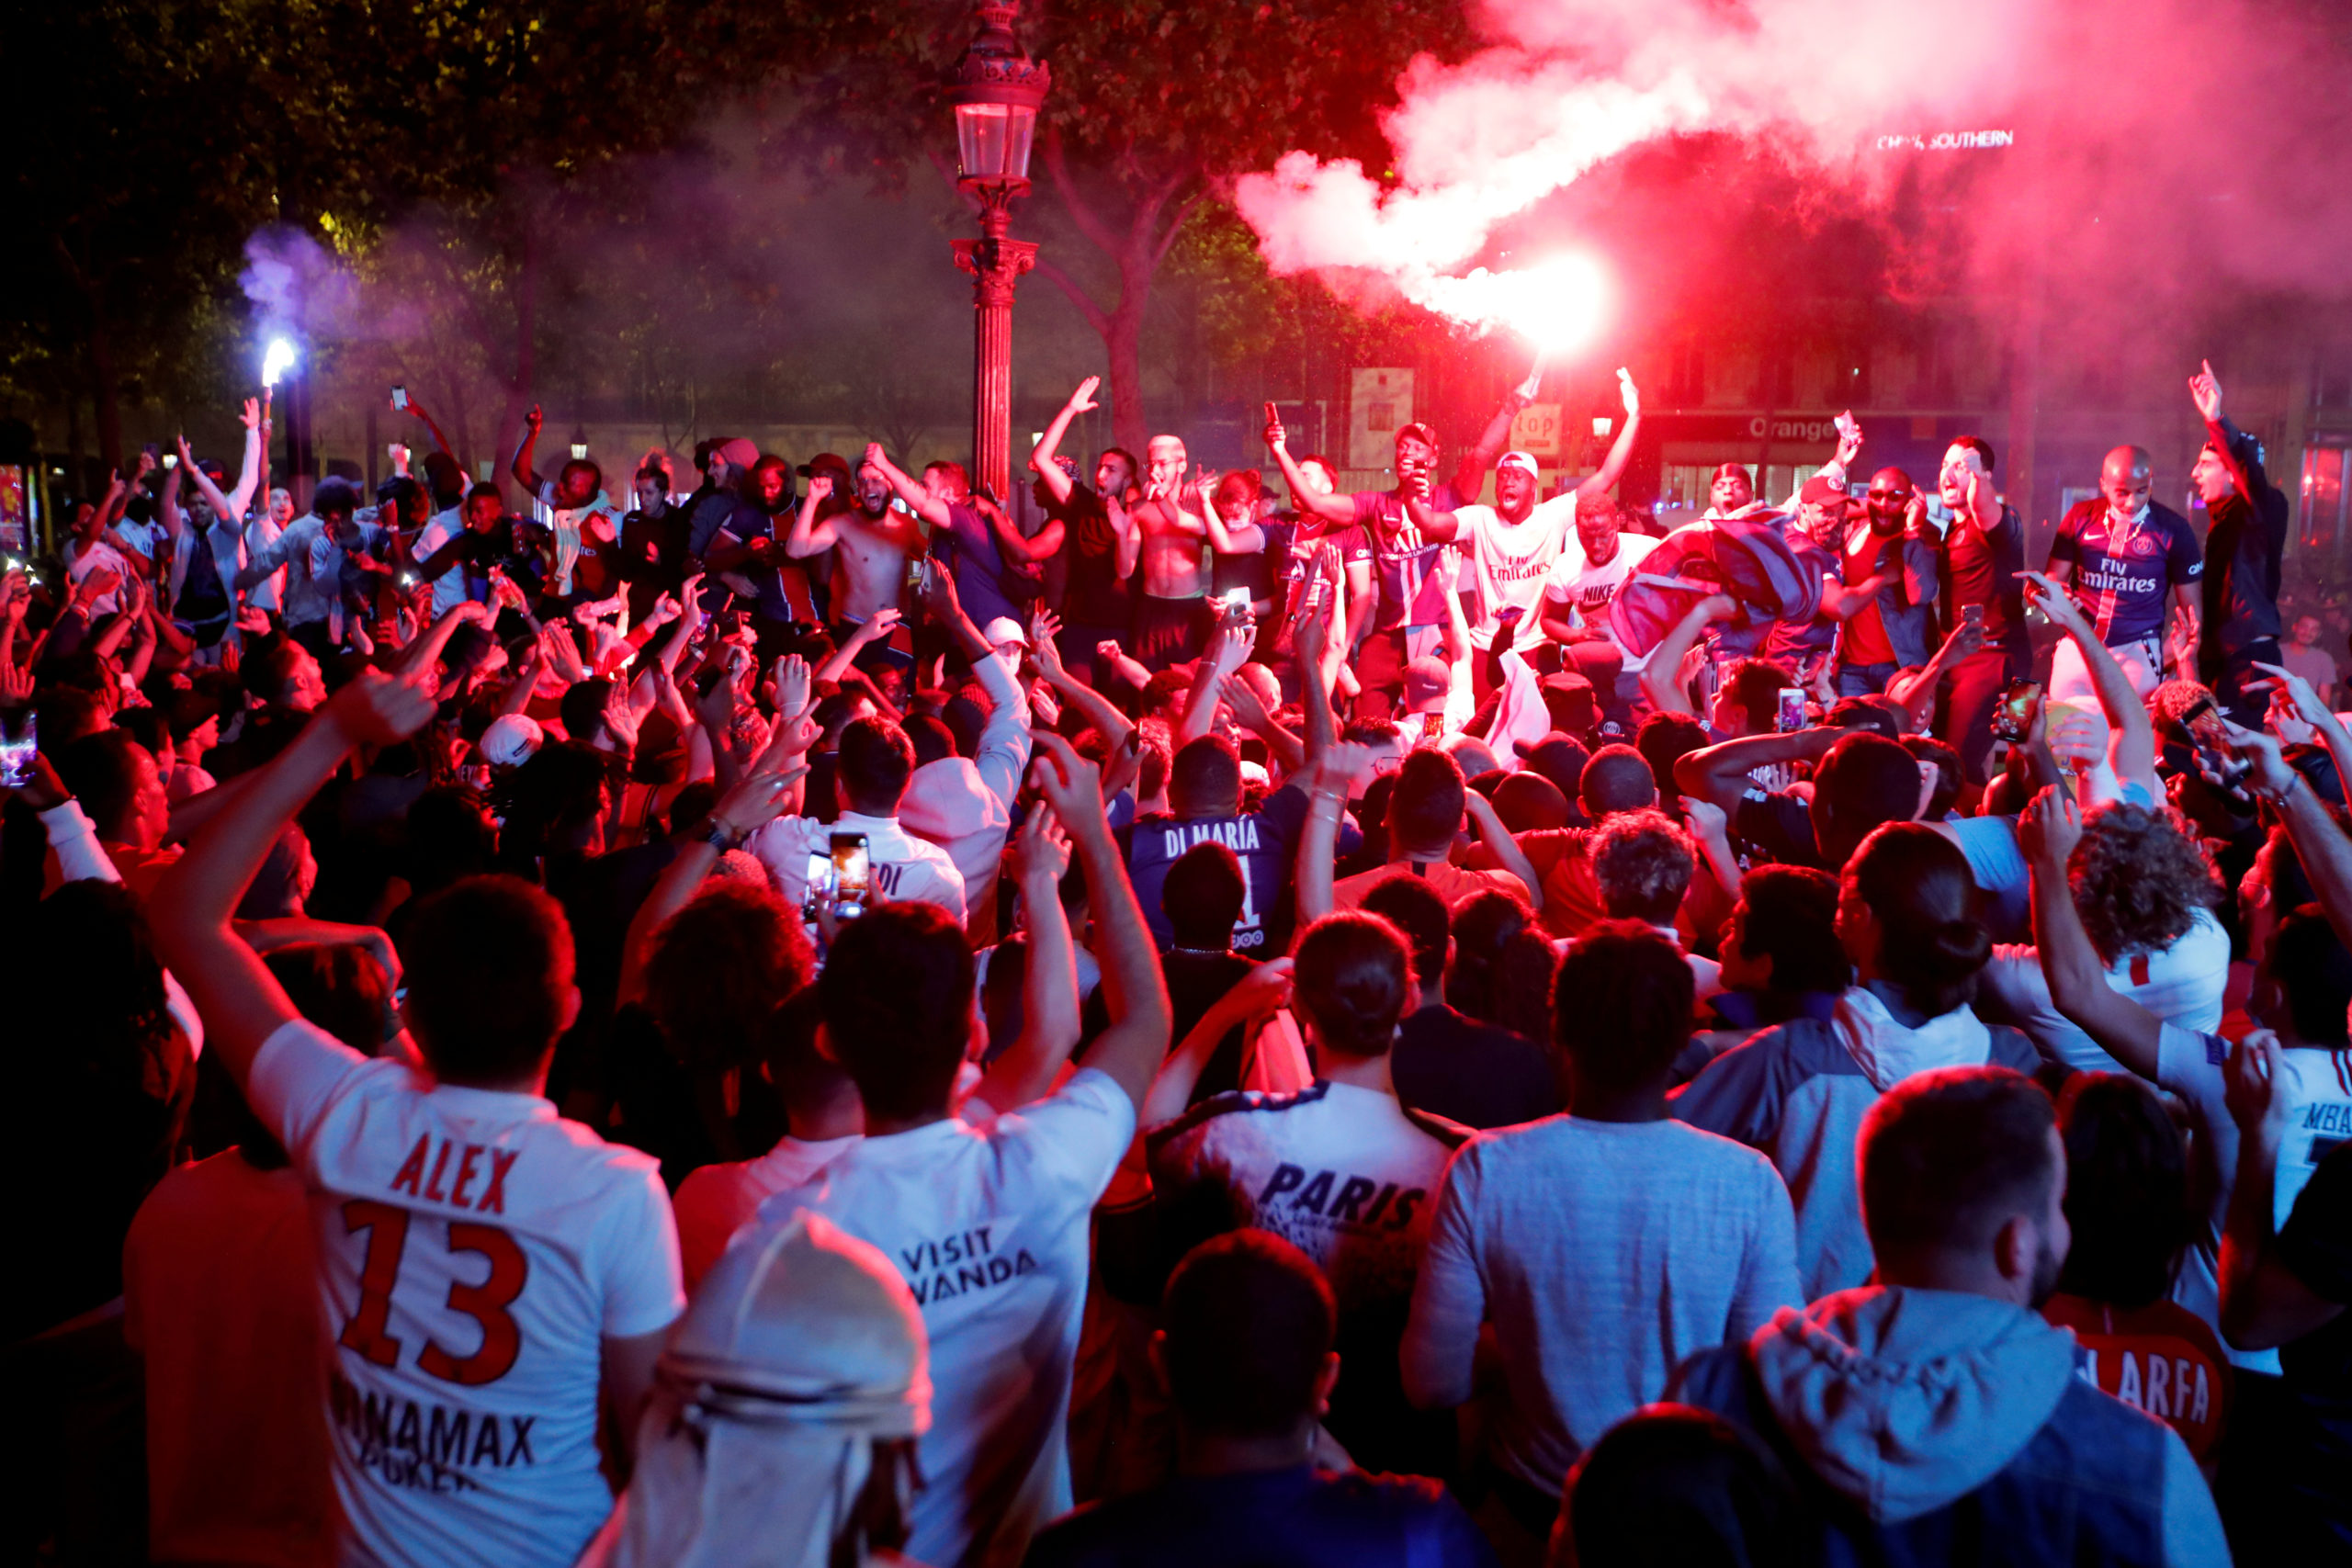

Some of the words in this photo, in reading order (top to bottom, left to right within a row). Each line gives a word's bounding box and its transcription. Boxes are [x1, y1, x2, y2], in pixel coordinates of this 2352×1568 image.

[1929, 129, 2014, 150] SOUTHERN
[1749, 416, 1837, 441] Orange
[1488, 560, 1551, 581] Emirates
[2077, 565, 2157, 593] Emirates
[2101, 558, 2127, 576] Fly
[1165, 828, 1187, 859] DI
[1193, 814, 1261, 851] MARÍA
[390, 1132, 522, 1215] ALEX
[1259, 1162, 1428, 1232] PARIS
[901, 1226, 992, 1272] VISIT
[340, 1197, 529, 1387] 13
[2117, 1350, 2210, 1425] ARFA
